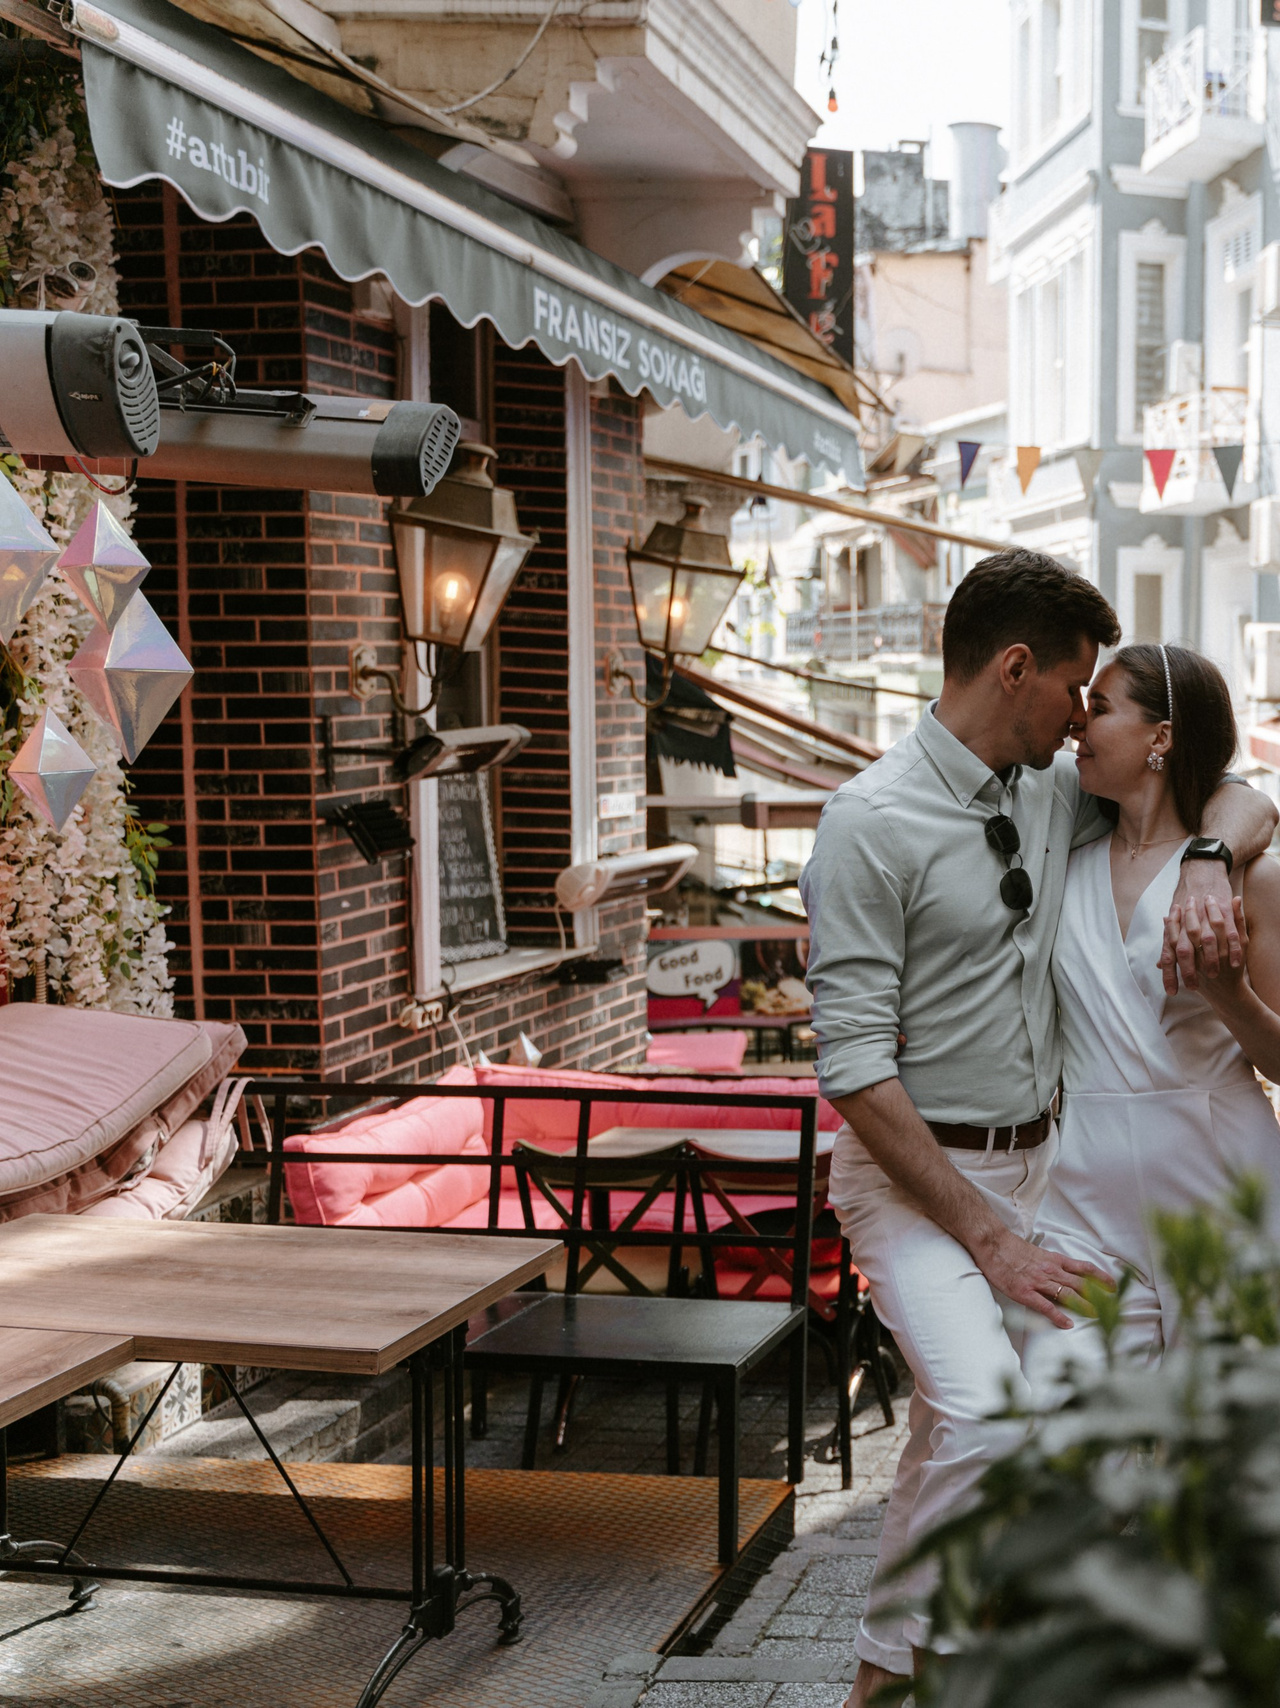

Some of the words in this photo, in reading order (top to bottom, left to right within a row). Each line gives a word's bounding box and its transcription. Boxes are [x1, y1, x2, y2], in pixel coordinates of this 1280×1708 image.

[533, 285, 632, 370] FRANSIZ
[637, 337, 708, 405] SOKAĞI
[658, 948, 699, 972] Good
[684, 965, 724, 990] Food
